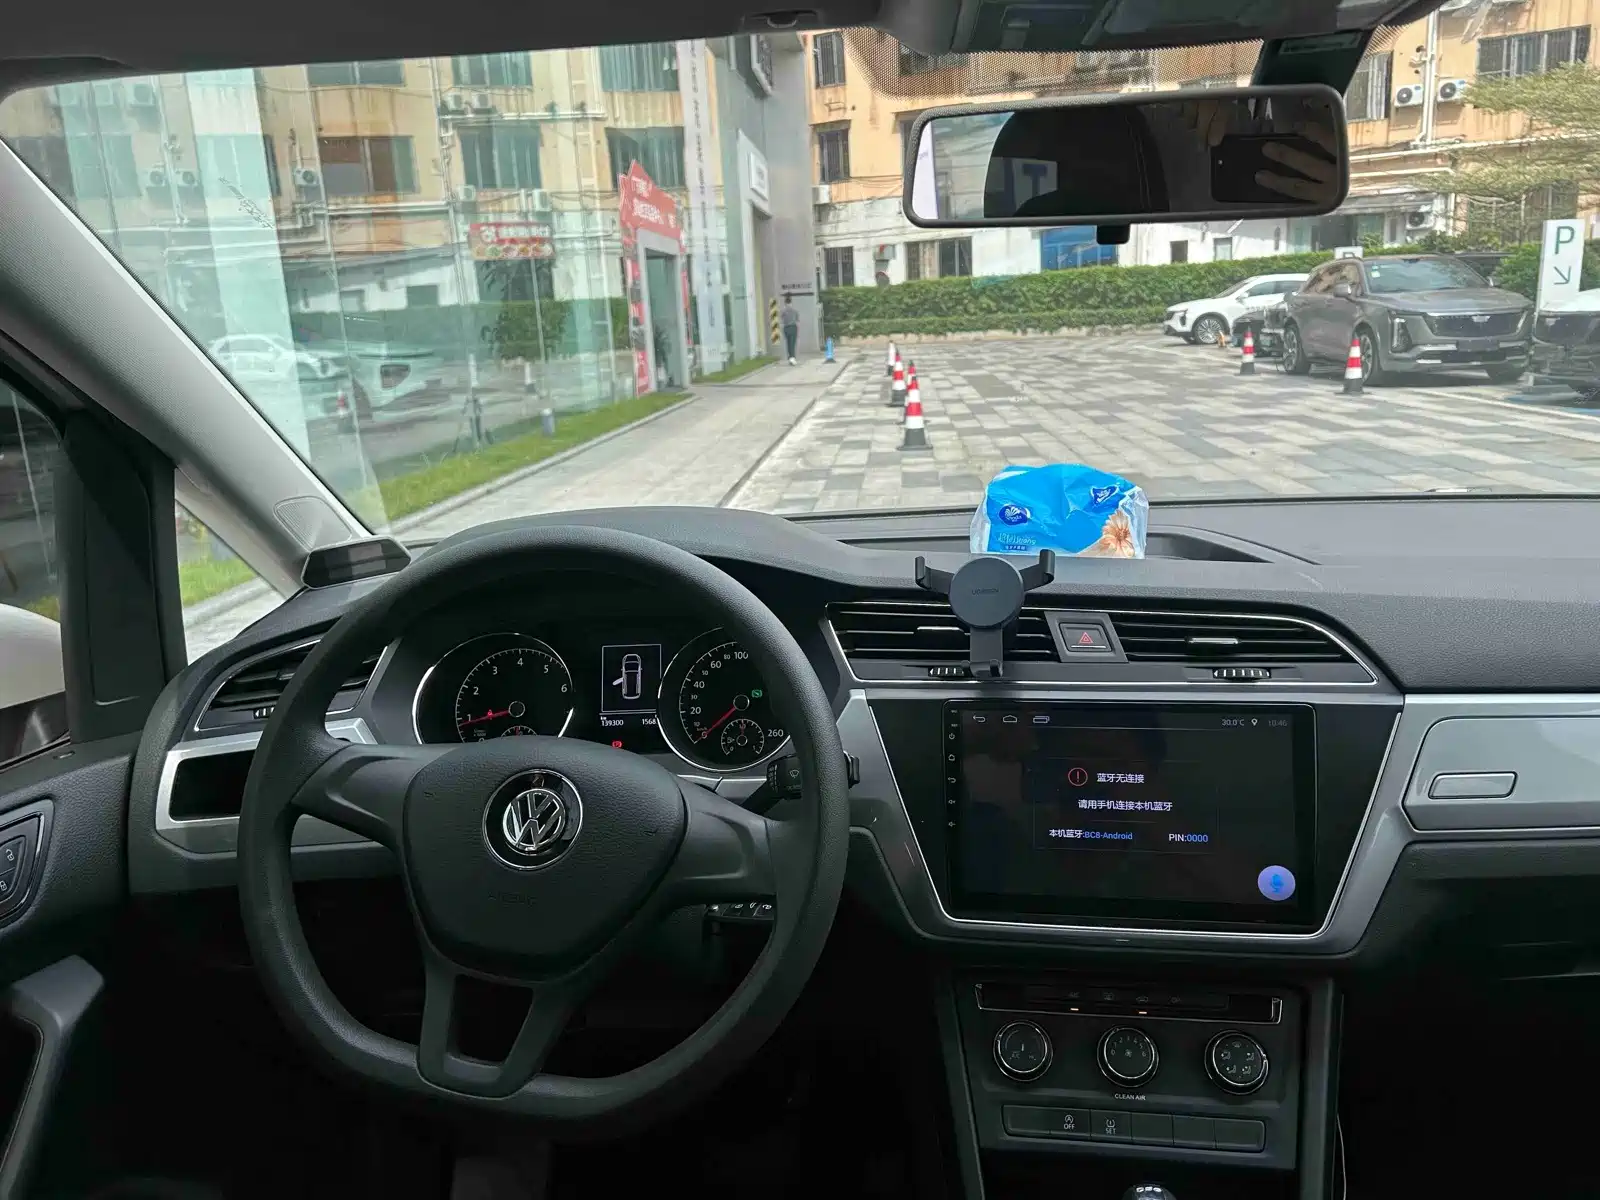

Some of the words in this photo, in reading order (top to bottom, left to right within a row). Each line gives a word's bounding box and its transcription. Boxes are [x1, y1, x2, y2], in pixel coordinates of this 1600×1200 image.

[1555, 226, 1574, 254] P
[734, 651, 749, 660] 100
[517, 657, 524, 667] 4
[710, 660, 722, 669] 60
[492, 665, 498, 675] 3
[543, 664, 549, 674] 5
[561, 683, 568, 693] 6
[693, 680, 705, 689] 40
[473, 686, 479, 695] 2
[690, 706, 702, 715] 20
[467, 713, 472, 722] 1
[601, 719, 624, 727] 139300
[767, 728, 784, 737] 260
[1096, 773, 1145, 784] 蓝牙无连接
[1078, 799, 1173, 811] 请用手机连接本机蓝牙
[1168, 833, 1209, 842] PIN:0000
[1105, 1127, 1116, 1135] SET
